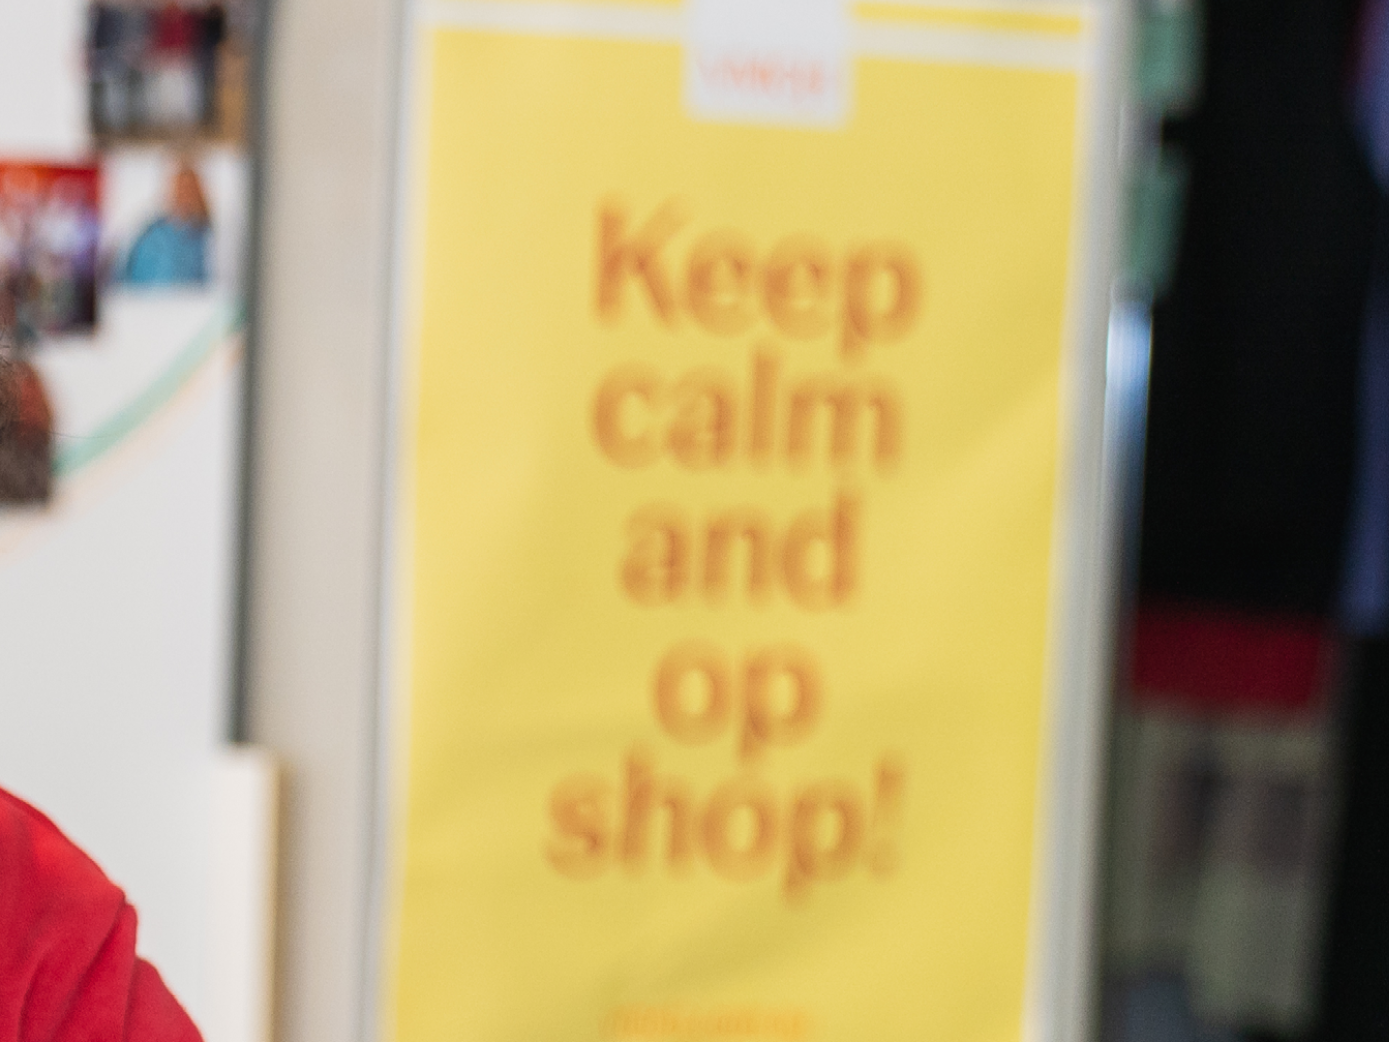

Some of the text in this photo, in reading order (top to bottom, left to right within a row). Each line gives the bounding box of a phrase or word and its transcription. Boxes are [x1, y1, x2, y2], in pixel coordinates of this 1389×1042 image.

[593, 196, 925, 364] Keep
[589, 346, 908, 478] calm
[617, 492, 862, 611] and
[650, 640, 824, 762] op
[544, 746, 909, 906] shop!
